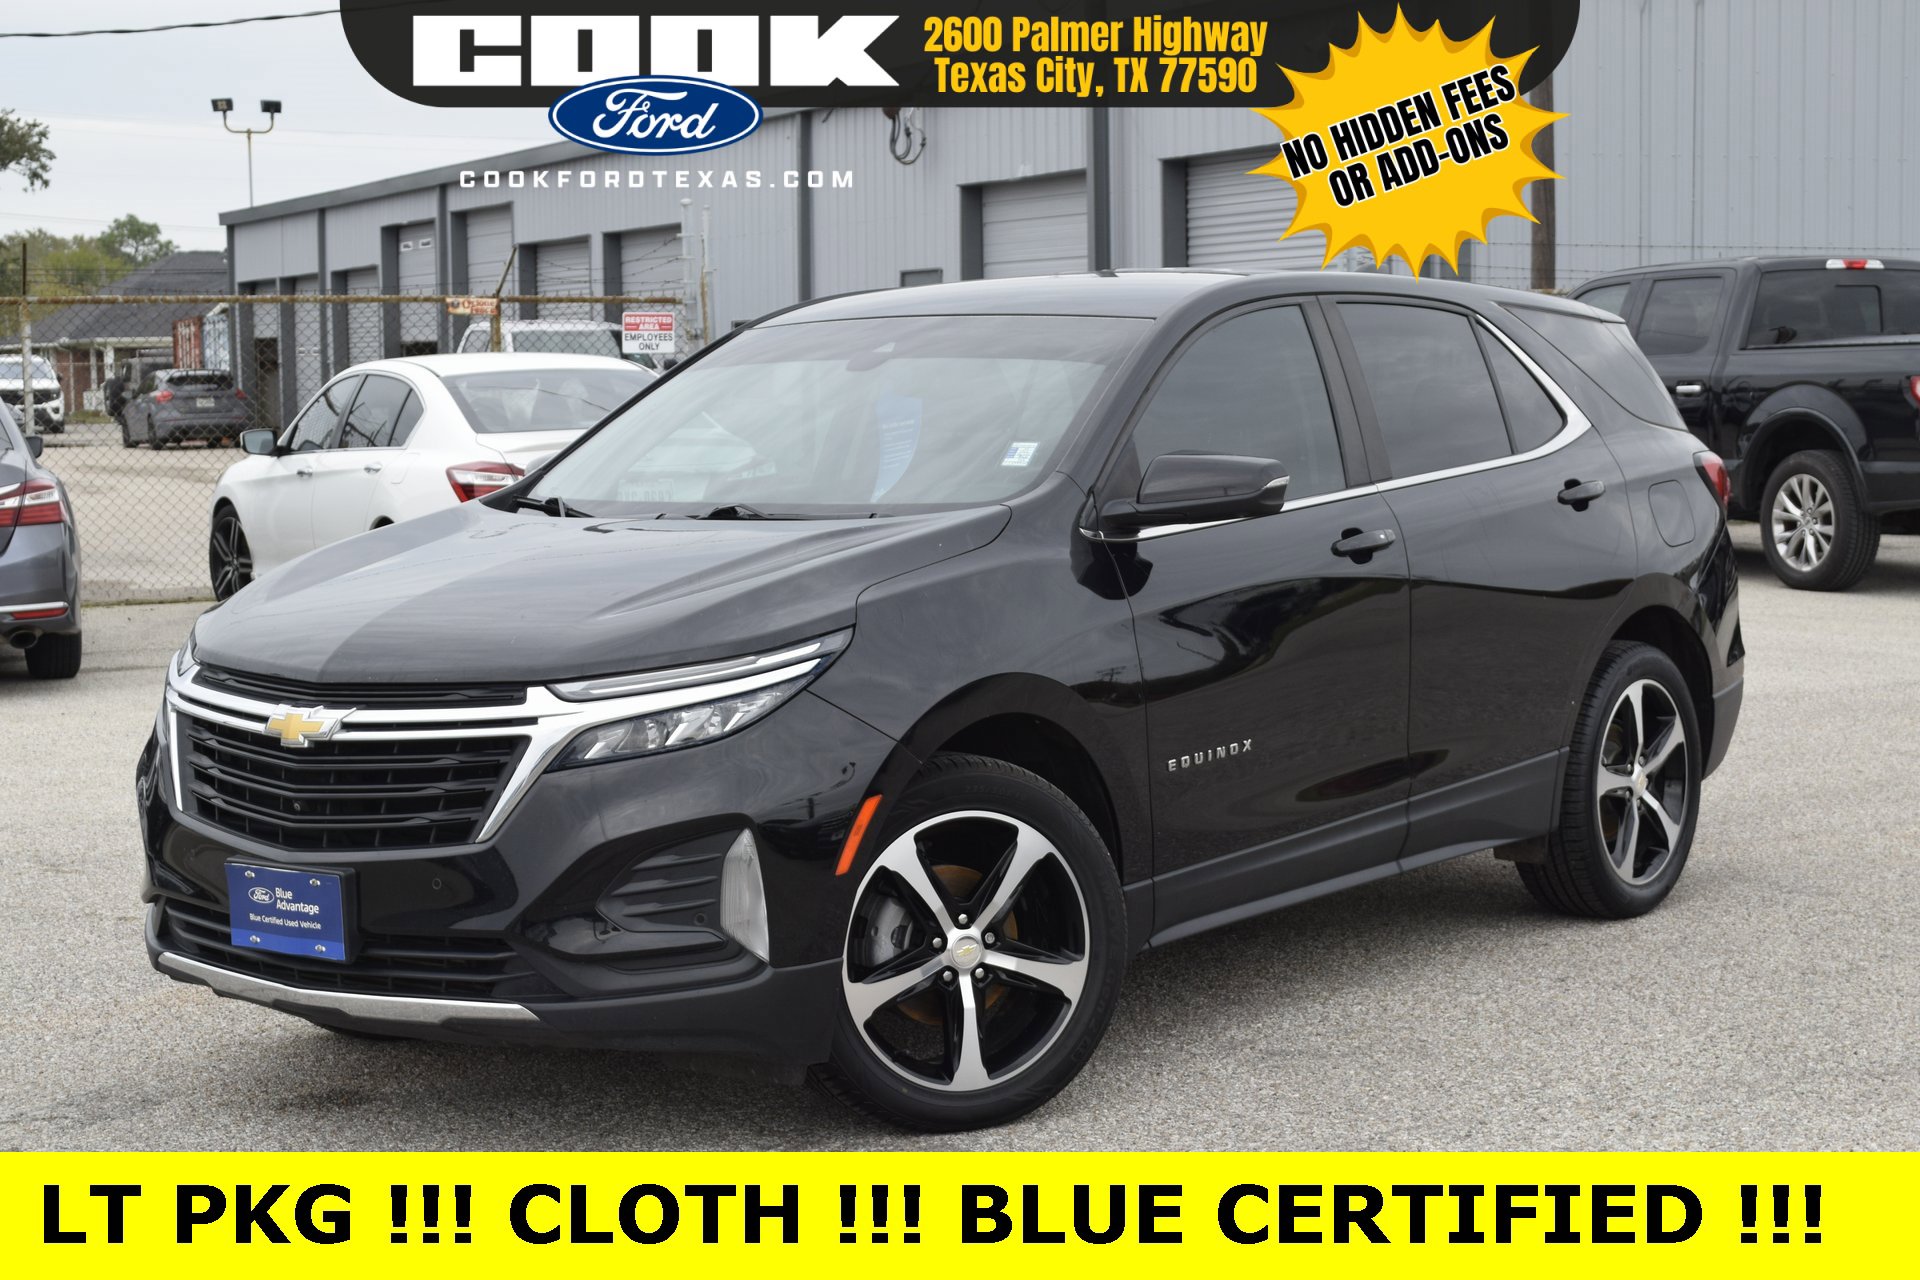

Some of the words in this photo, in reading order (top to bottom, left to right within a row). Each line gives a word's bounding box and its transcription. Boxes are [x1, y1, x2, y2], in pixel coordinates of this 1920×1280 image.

[640, 322, 660, 330] AREA
[624, 333, 673, 341] EMPLOYEES
[638, 342, 660, 350] ONLY
[1167, 738, 1252, 772] EQUINOX
[253, 888, 270, 902] Ford
[275, 887, 293, 900] Blue
[276, 899, 320, 915] Advantage
[249, 913, 262, 923] Blue
[261, 914, 284, 926] Certified
[284, 919, 299, 928] Used
[299, 920, 322, 930] Vehicle
